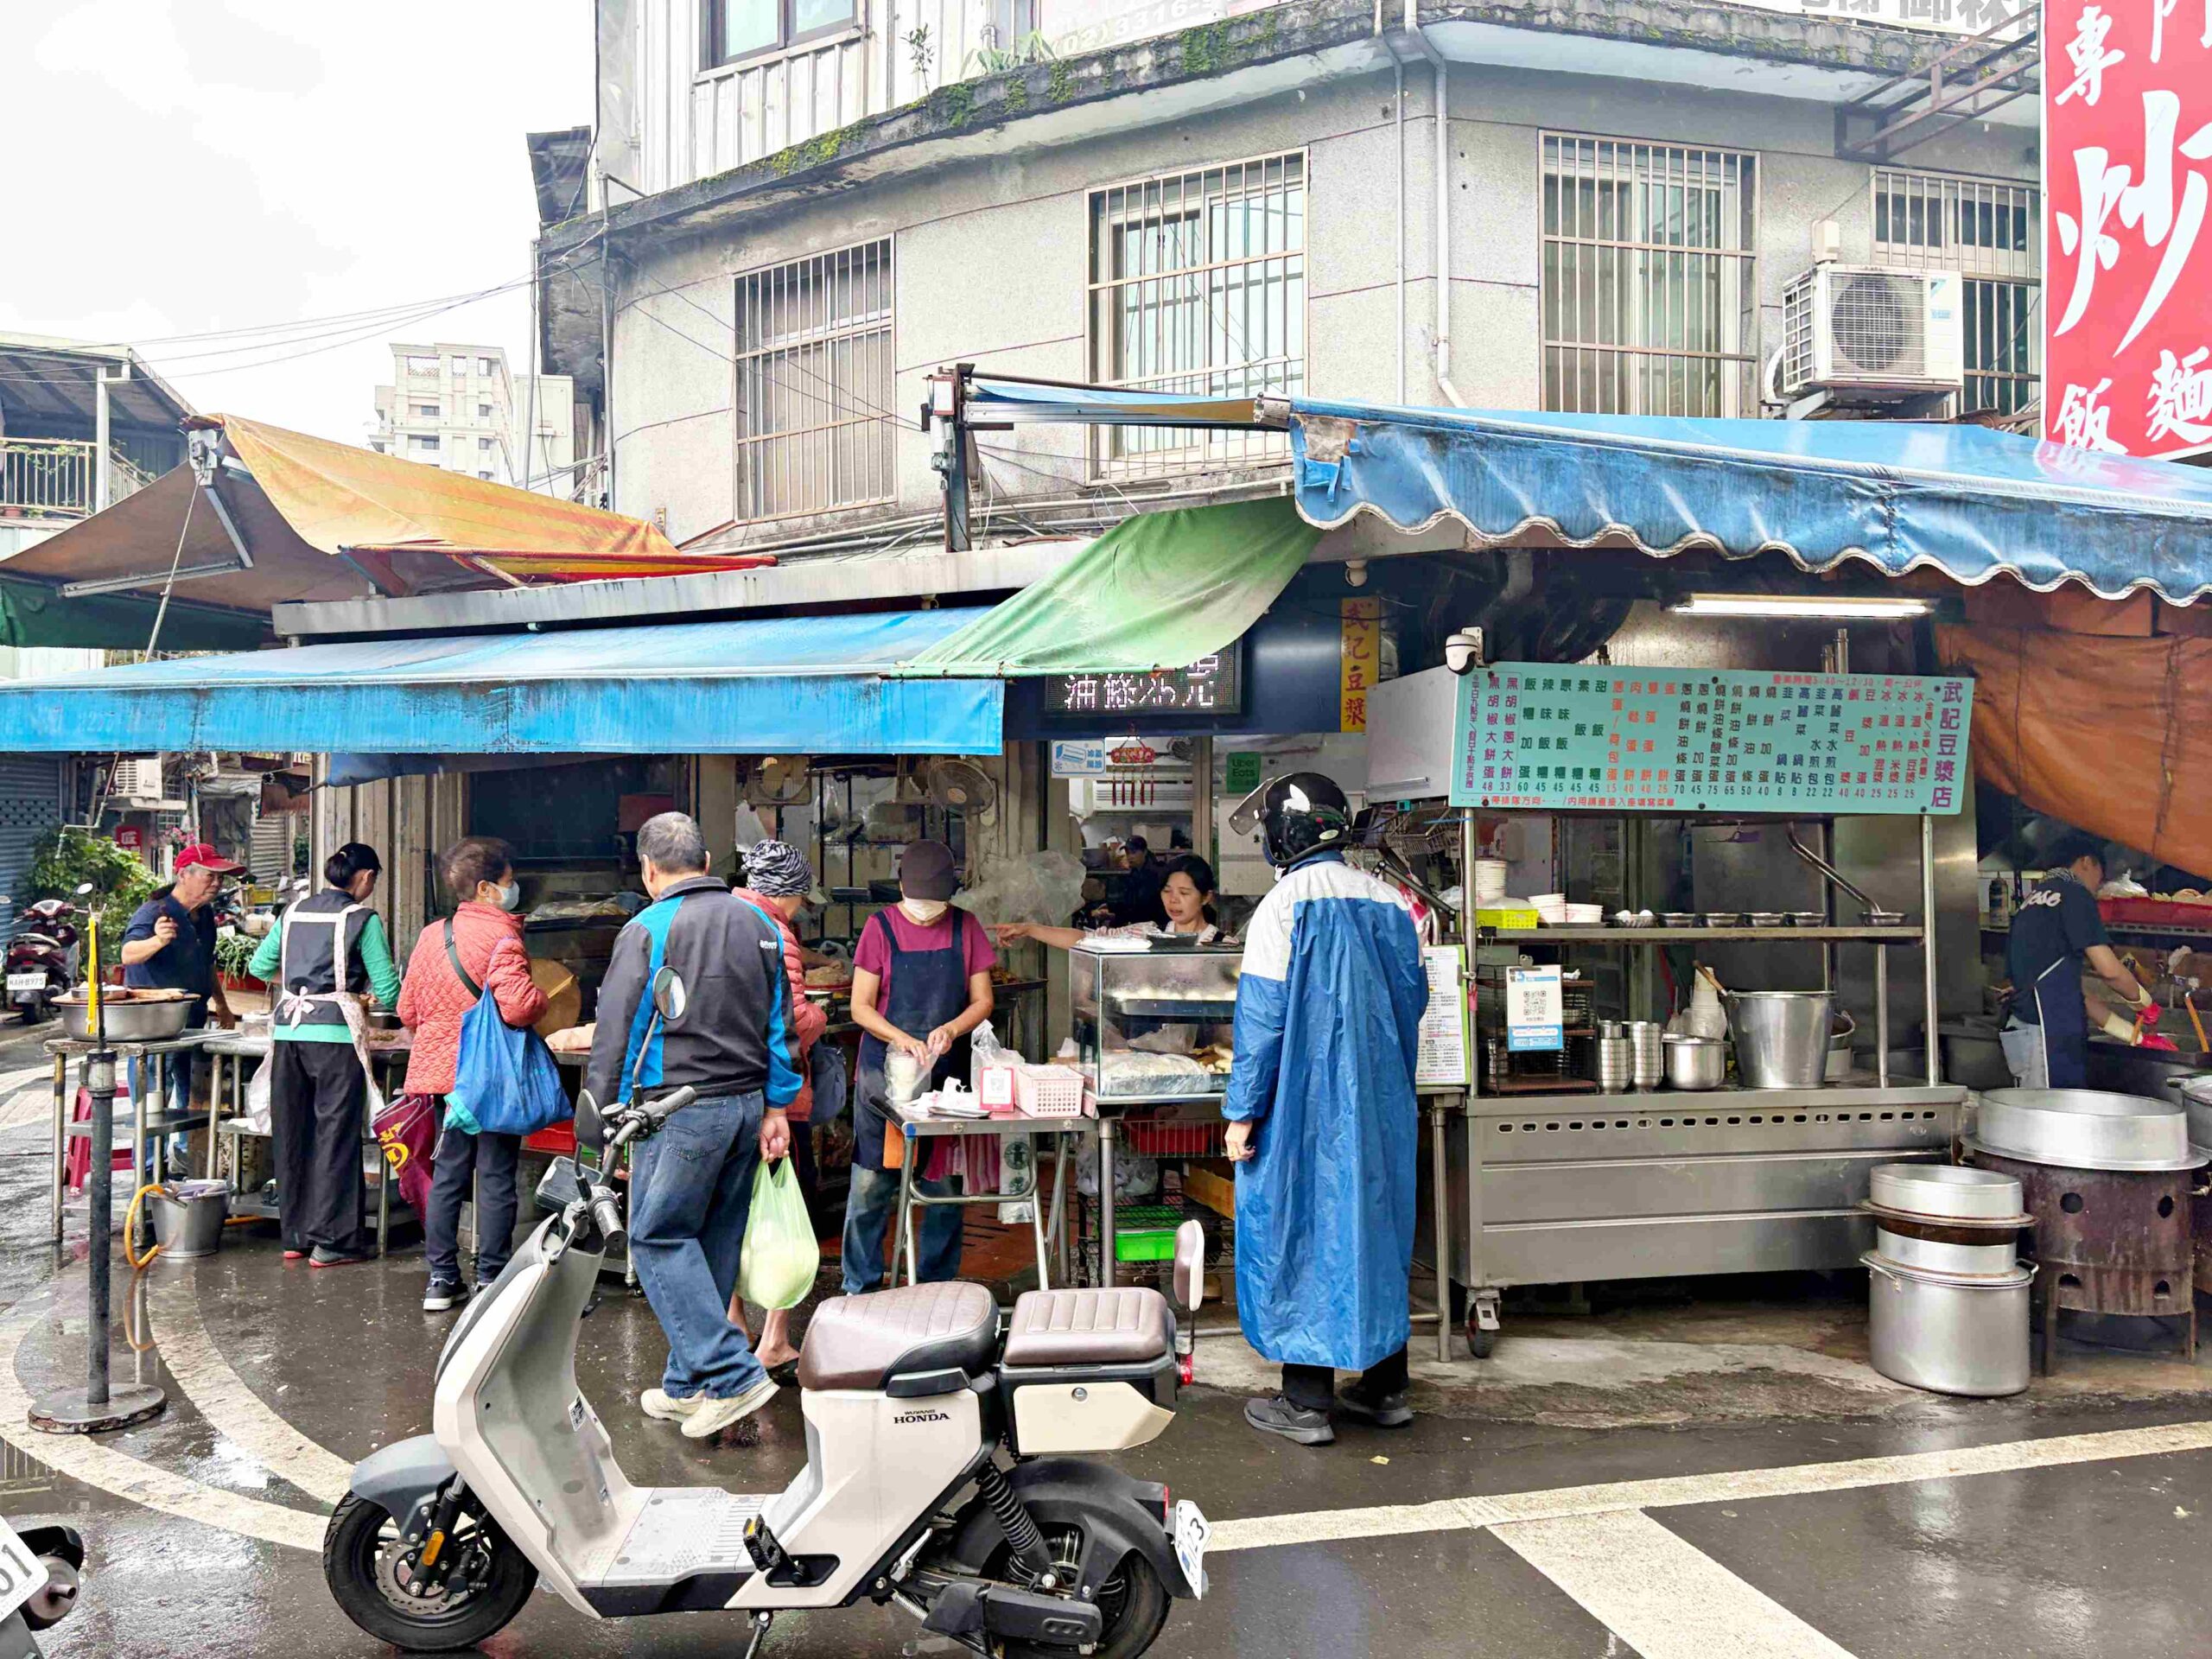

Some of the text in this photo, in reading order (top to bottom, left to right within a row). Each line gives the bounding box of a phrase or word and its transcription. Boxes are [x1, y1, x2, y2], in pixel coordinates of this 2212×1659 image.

[2053, 90, 2212, 358] 炒
[1931, 682, 1963, 808] 武記豆漿店
[1232, 759, 1255, 767] Uber
[1232, 768, 1256, 777] Eats
[1482, 782, 1493, 791] 48
[1500, 782, 1510, 791] 33
[1518, 782, 1529, 791] 60
[1535, 782, 1546, 792] 45
[1554, 783, 1564, 792] 45
[1570, 783, 1581, 792] 45
[1589, 783, 1599, 792] 45
[1606, 784, 1617, 793] 15
[1624, 784, 1634, 793] 40
[1674, 785, 1684, 794] 70
[1691, 785, 1700, 794] 45
[1708, 785, 1719, 794] 75
[1724, 785, 1734, 795] 65
[1741, 785, 1751, 795] 50
[1758, 785, 1769, 796] 40
[1777, 786, 1783, 796] 8
[1792, 786, 1797, 796] 8
[1807, 787, 1817, 797] 22
[1822, 787, 1833, 797] 22
[1839, 788, 1849, 798] 40
[1855, 788, 1866, 798] 40
[1872, 788, 1882, 798] 25
[1888, 789, 1898, 798] 25
[1904, 789, 1915, 798] 25
[893, 1413, 952, 1424] HONDA
